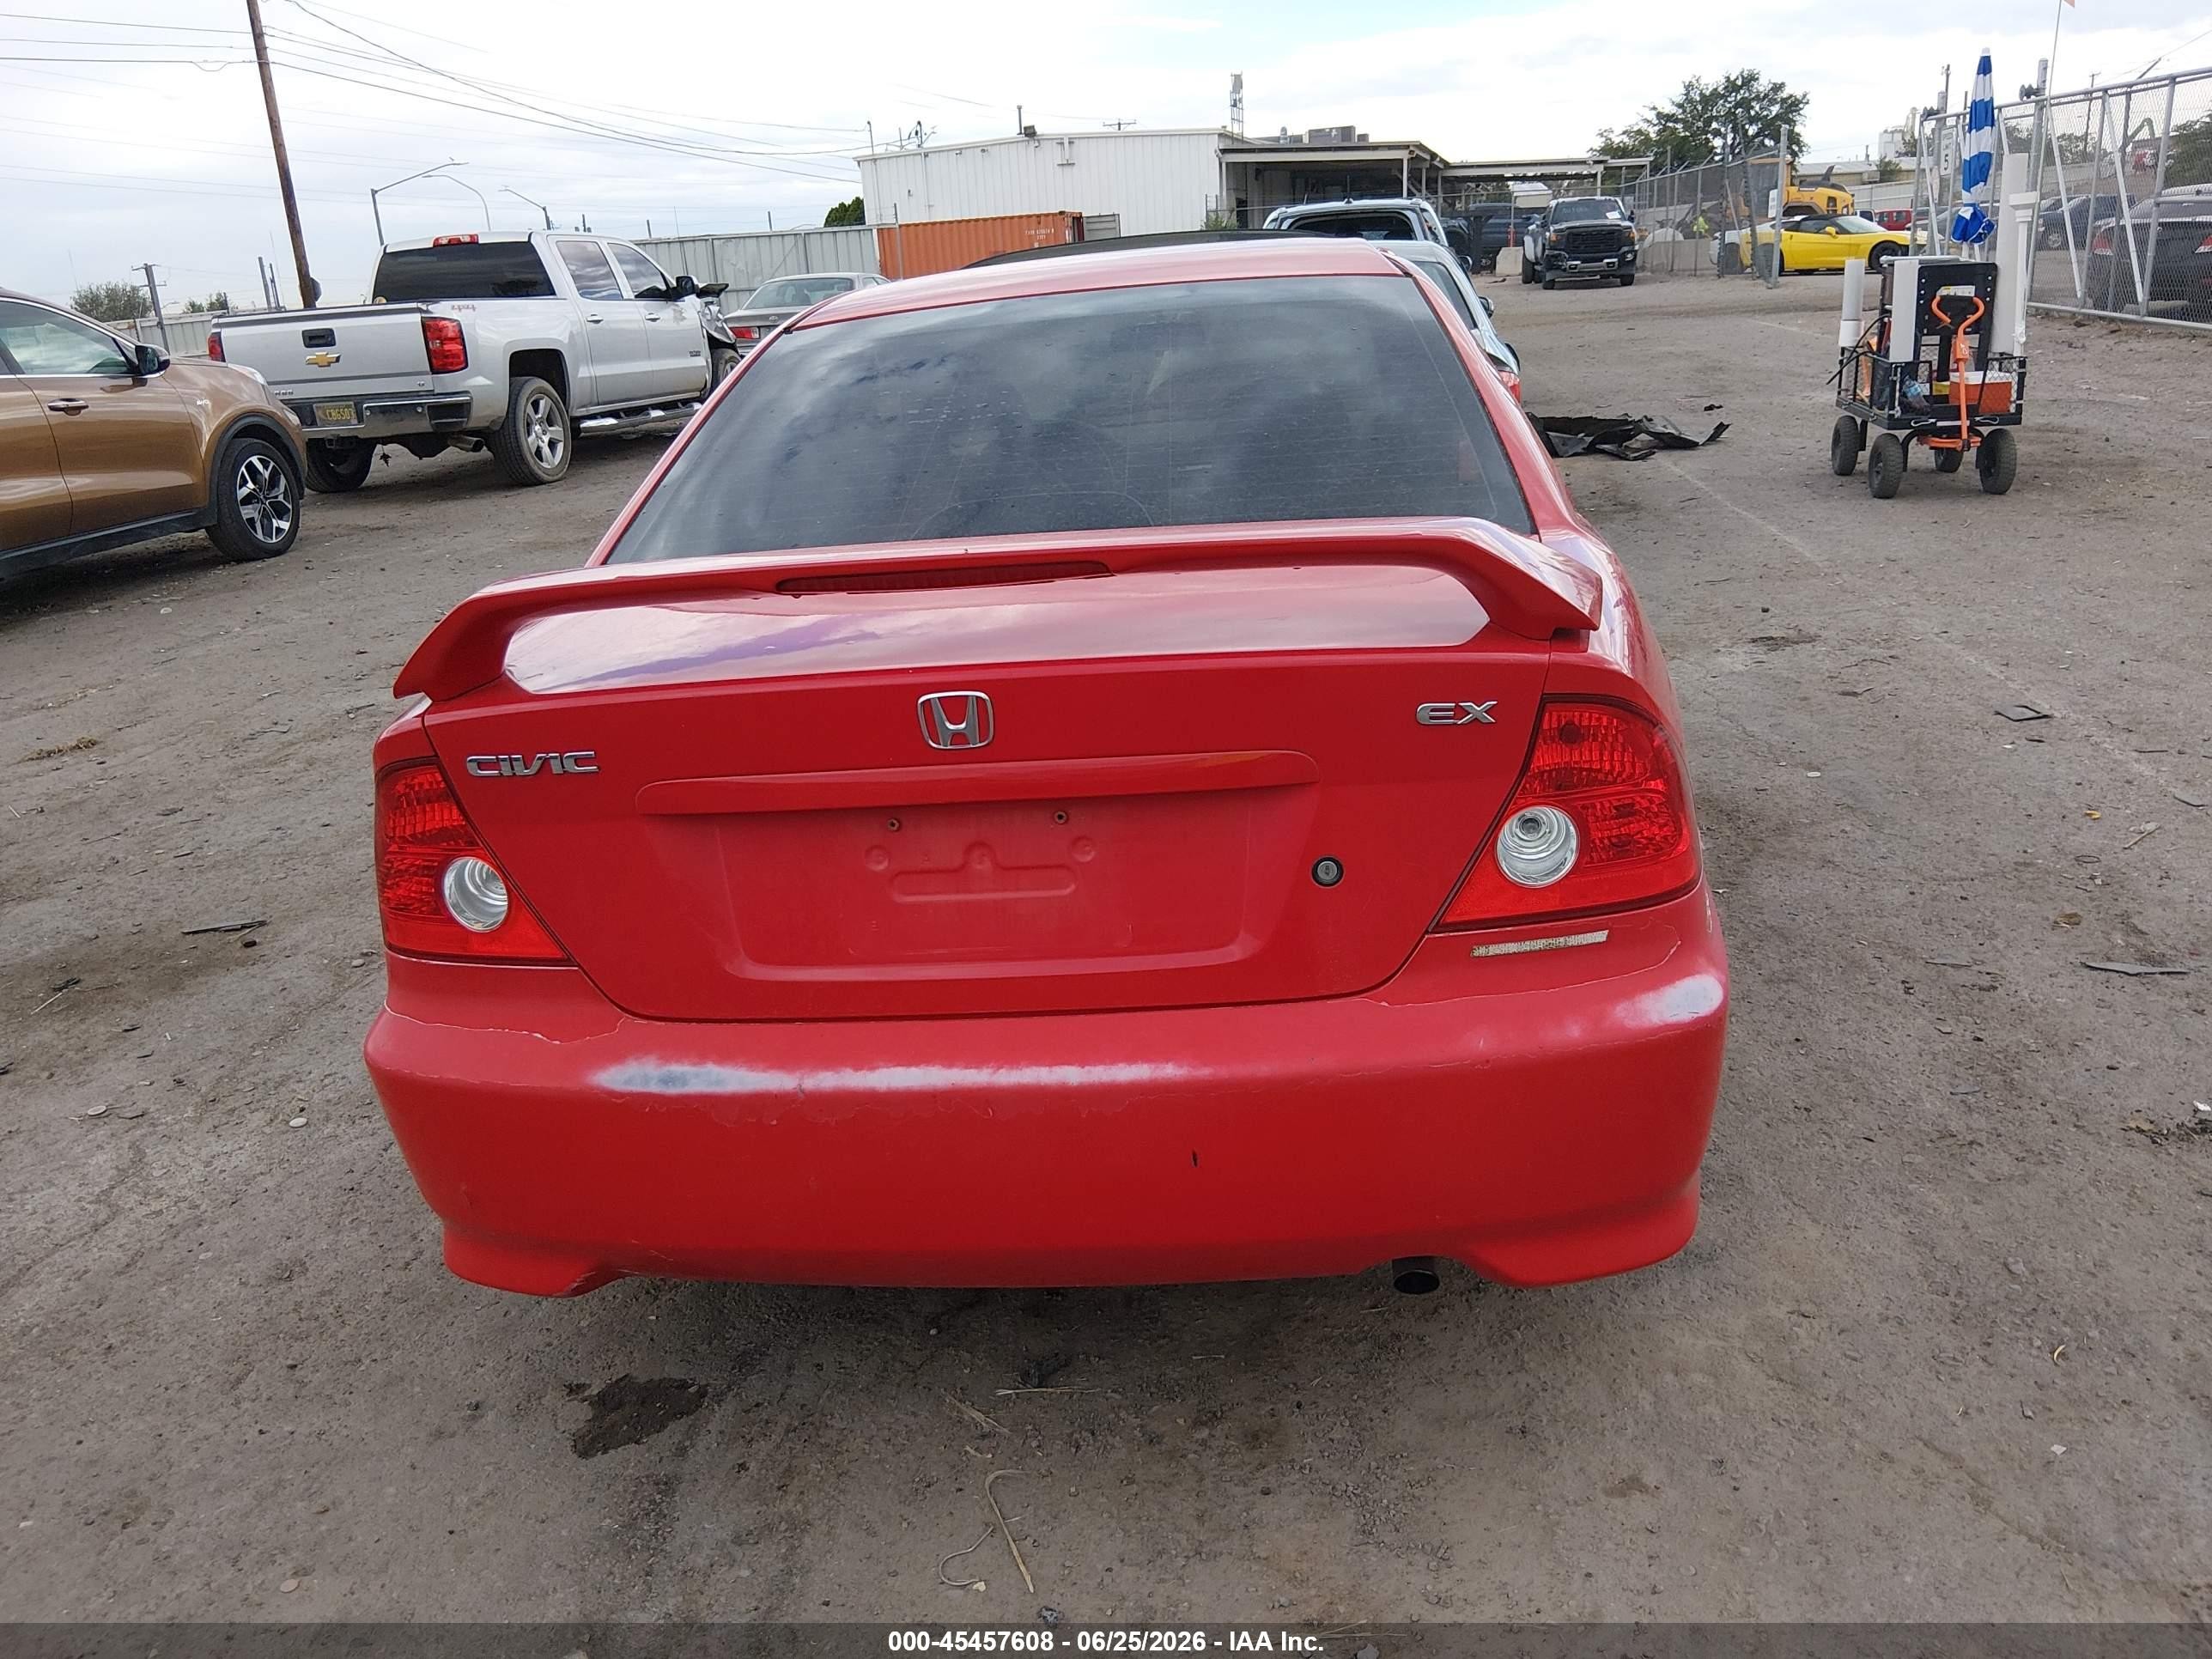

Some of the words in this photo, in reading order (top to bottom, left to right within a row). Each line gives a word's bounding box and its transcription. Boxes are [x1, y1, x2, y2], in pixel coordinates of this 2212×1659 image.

[1944, 154, 1949, 171] 5
[1416, 701, 1498, 725] EX
[466, 750, 599, 776] CIVIC
